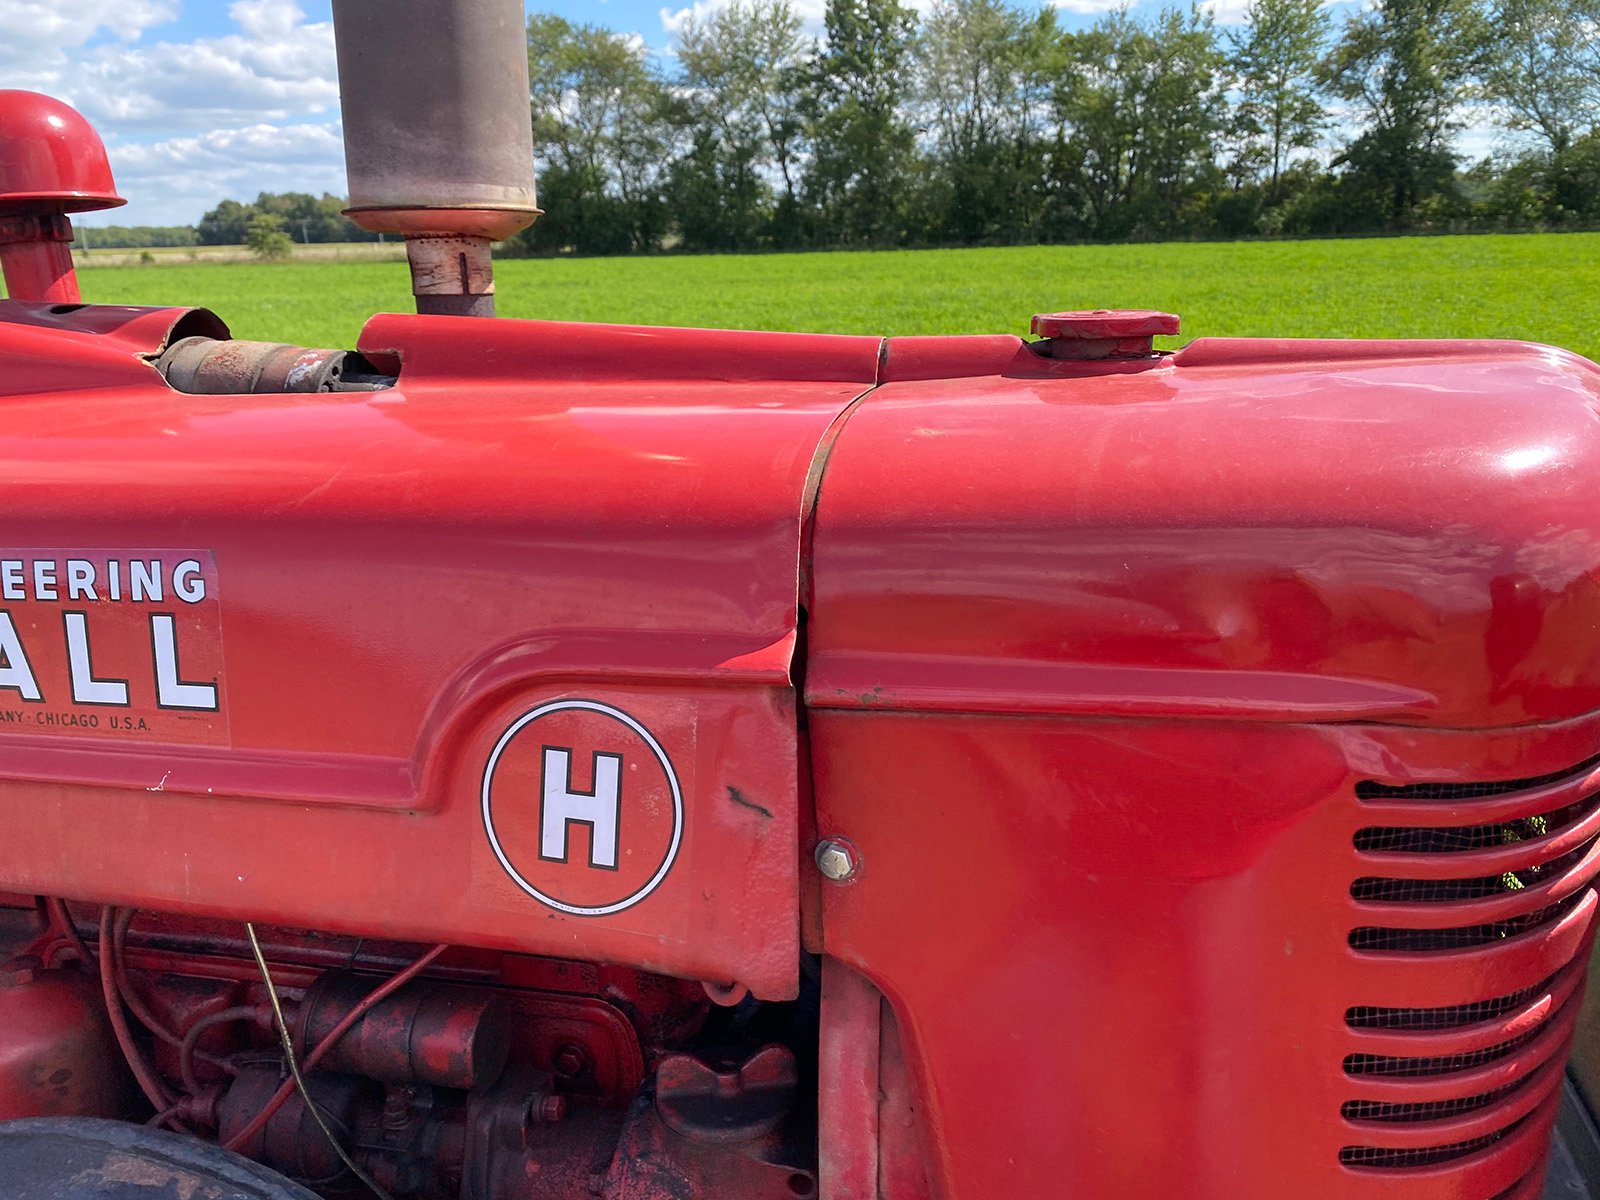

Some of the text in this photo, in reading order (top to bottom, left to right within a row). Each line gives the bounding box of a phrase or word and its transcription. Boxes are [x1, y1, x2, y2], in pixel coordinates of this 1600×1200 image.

[0, 559, 206, 603] EERING
[36, 711, 98, 728] CHICAGO
[110, 716, 151, 731] U.S.A.
[538, 744, 623, 871] H
